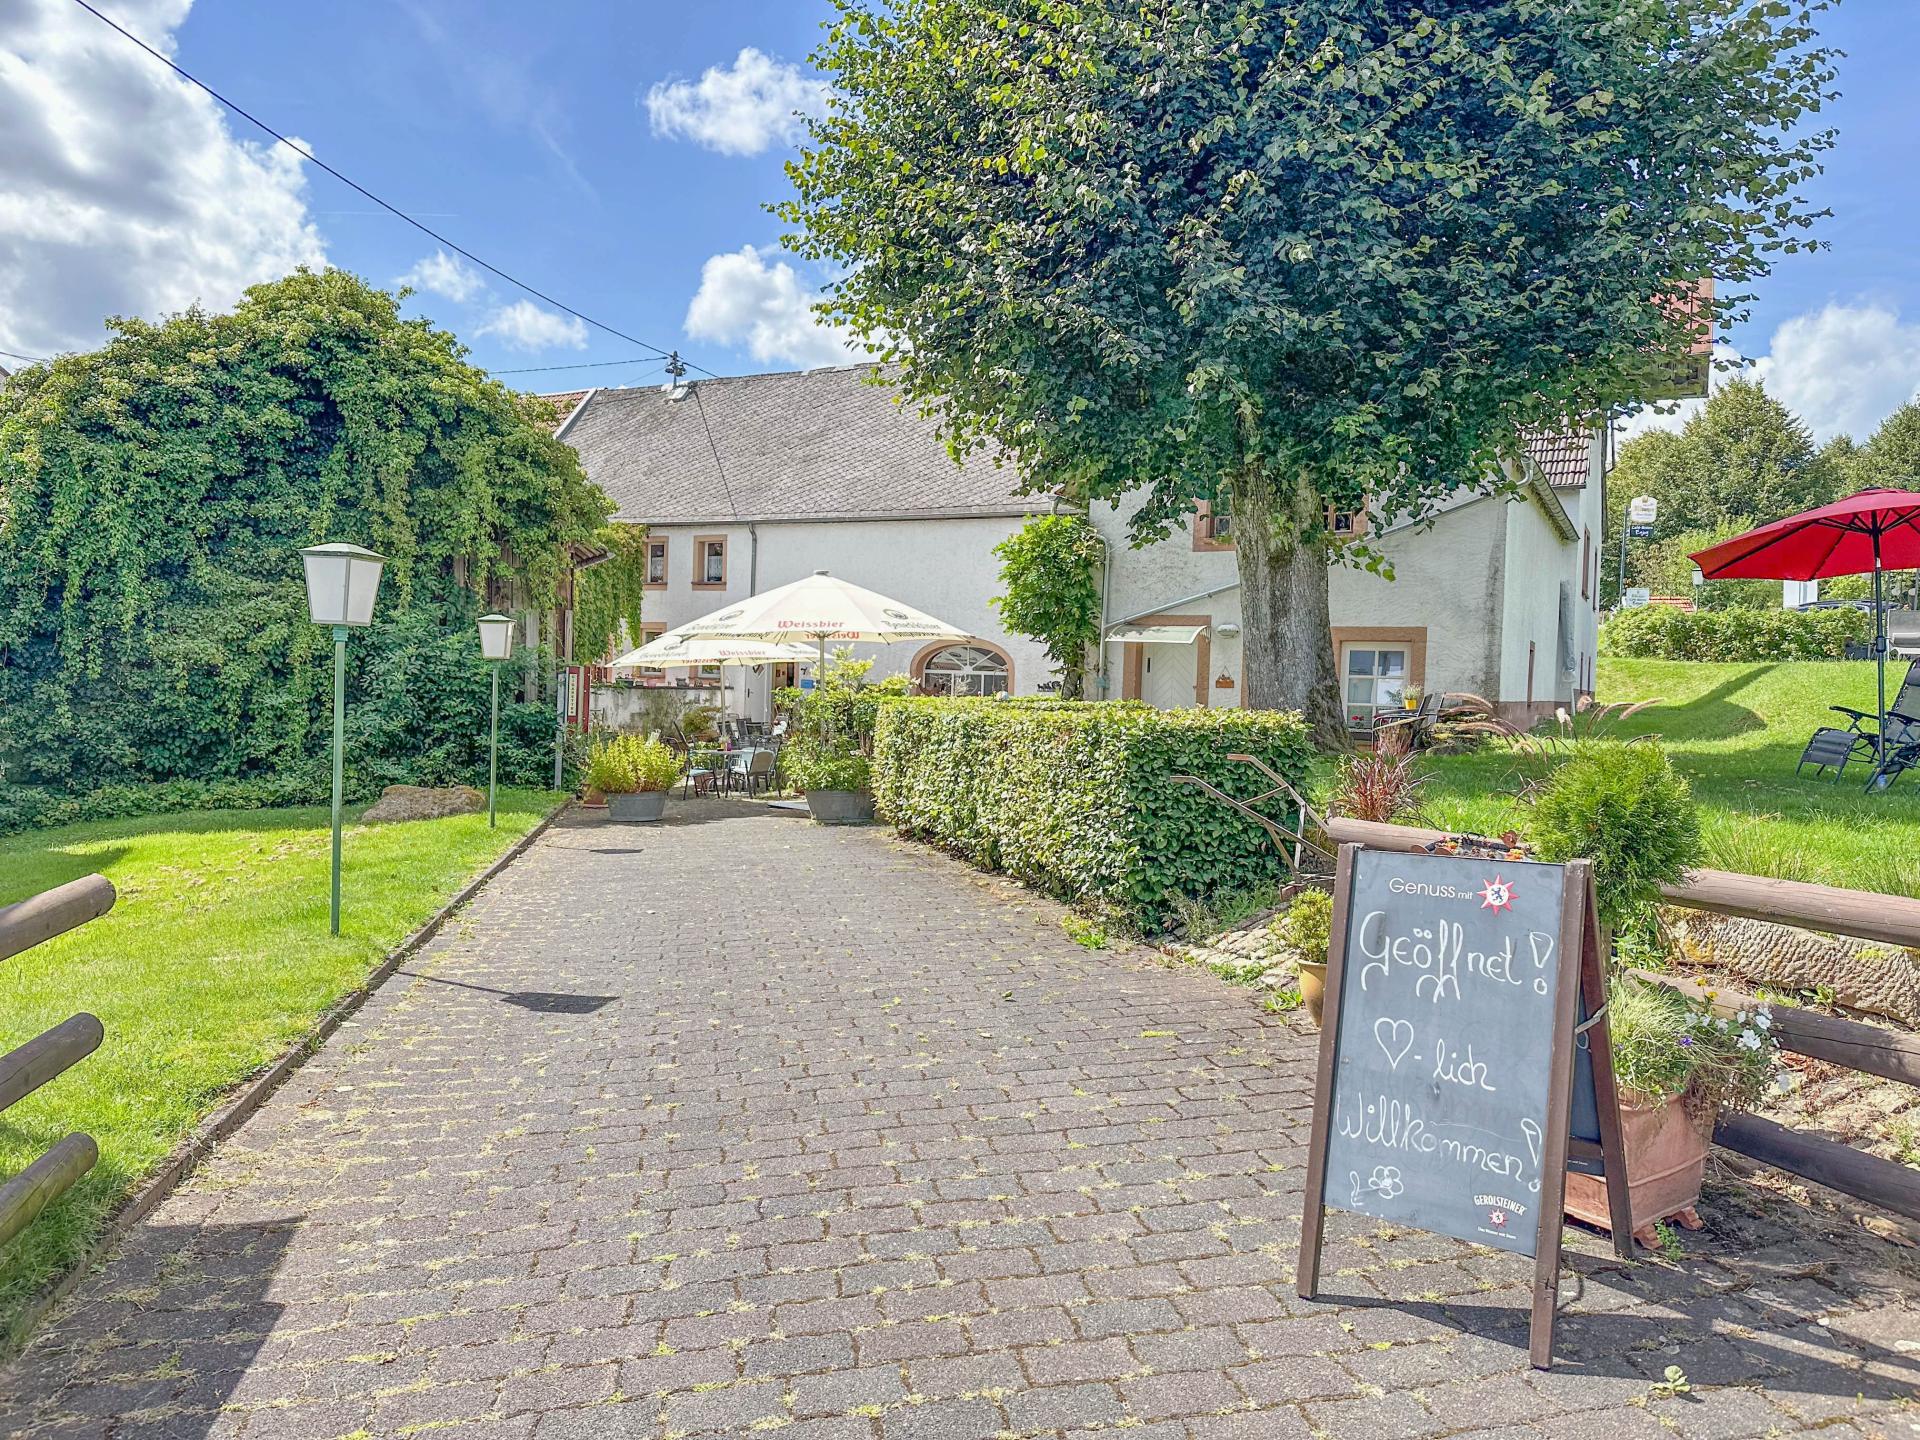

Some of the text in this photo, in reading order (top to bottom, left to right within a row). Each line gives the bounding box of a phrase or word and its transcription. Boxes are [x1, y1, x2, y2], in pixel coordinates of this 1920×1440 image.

[777, 620, 845, 629] Weissbier
[1389, 877, 1473, 900] Genuss mit
[1473, 1194, 1527, 1216] GEROLSTEINER
